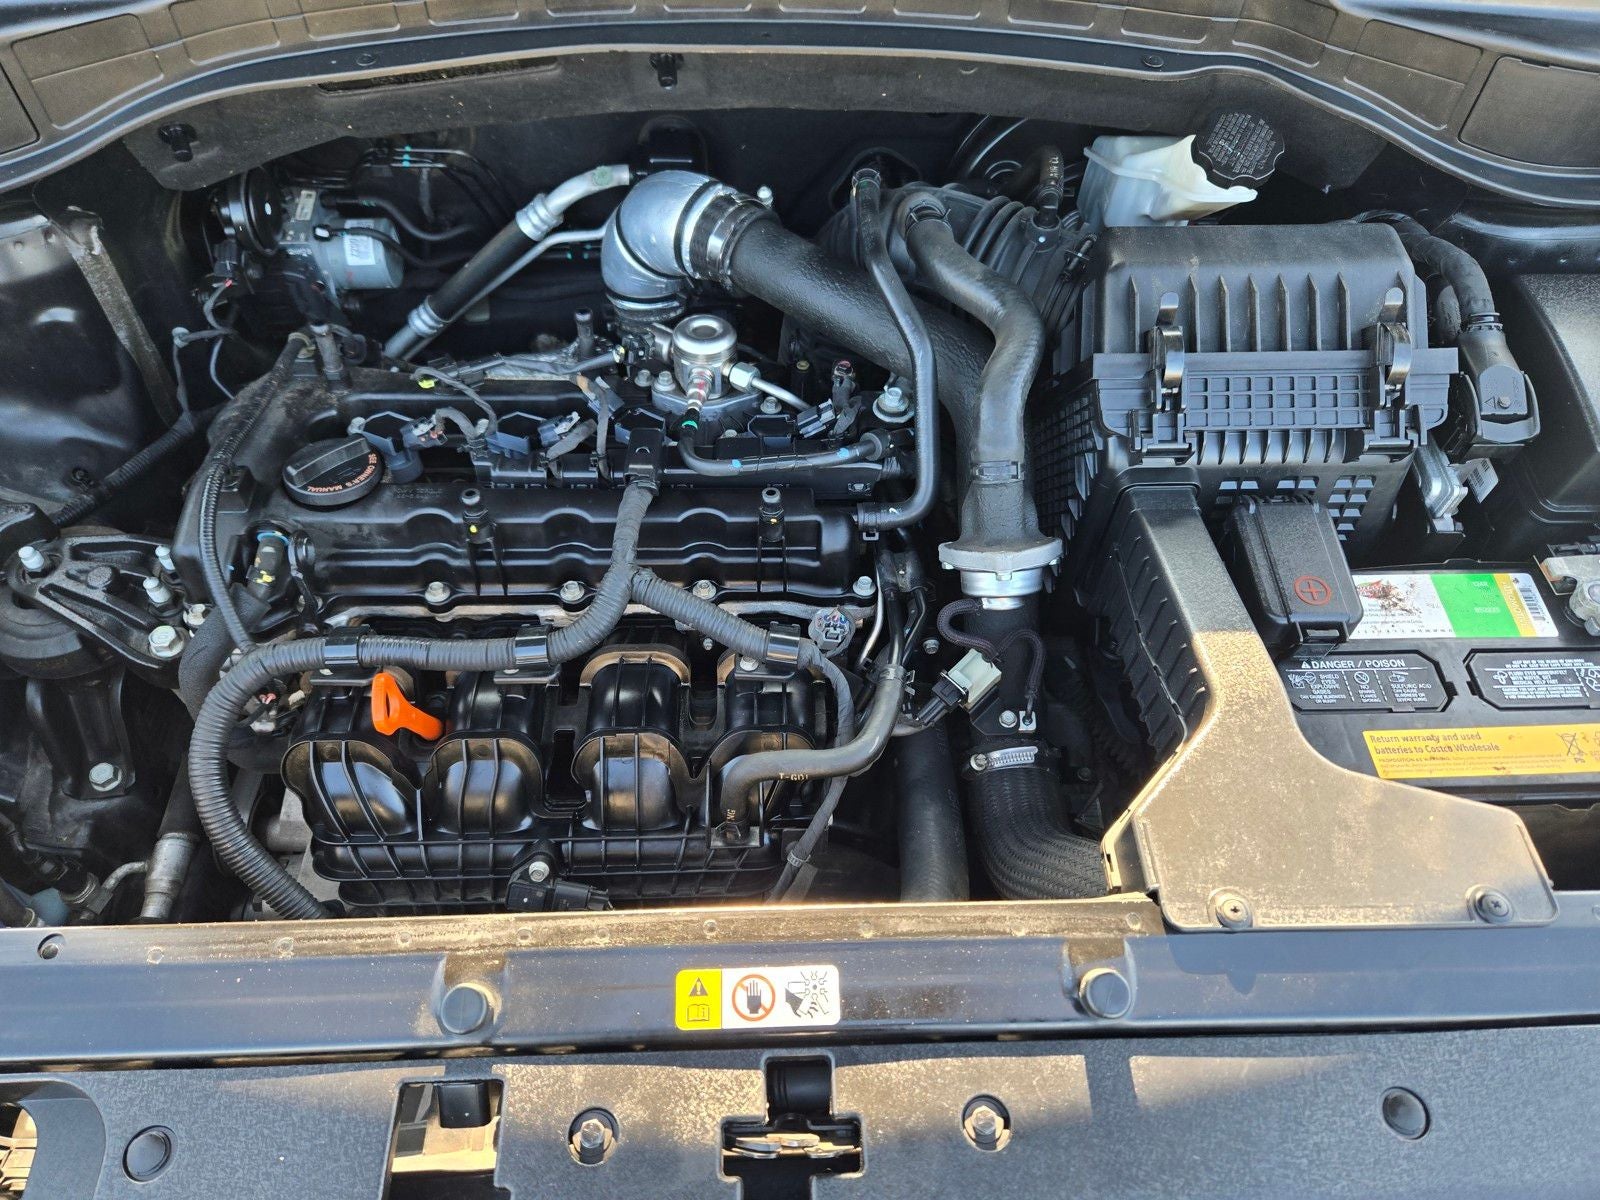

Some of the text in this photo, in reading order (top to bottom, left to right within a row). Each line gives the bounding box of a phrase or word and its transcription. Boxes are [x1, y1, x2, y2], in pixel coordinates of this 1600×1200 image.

[307, 453, 378, 493] SEE OWNER'S MANUAL
[1311, 660, 1354, 669] DANGER
[1364, 659, 1406, 668] POISON
[1369, 731, 1481, 744] Return warranty and used
[1375, 743, 1500, 755] batteries to Costco Wholesale
